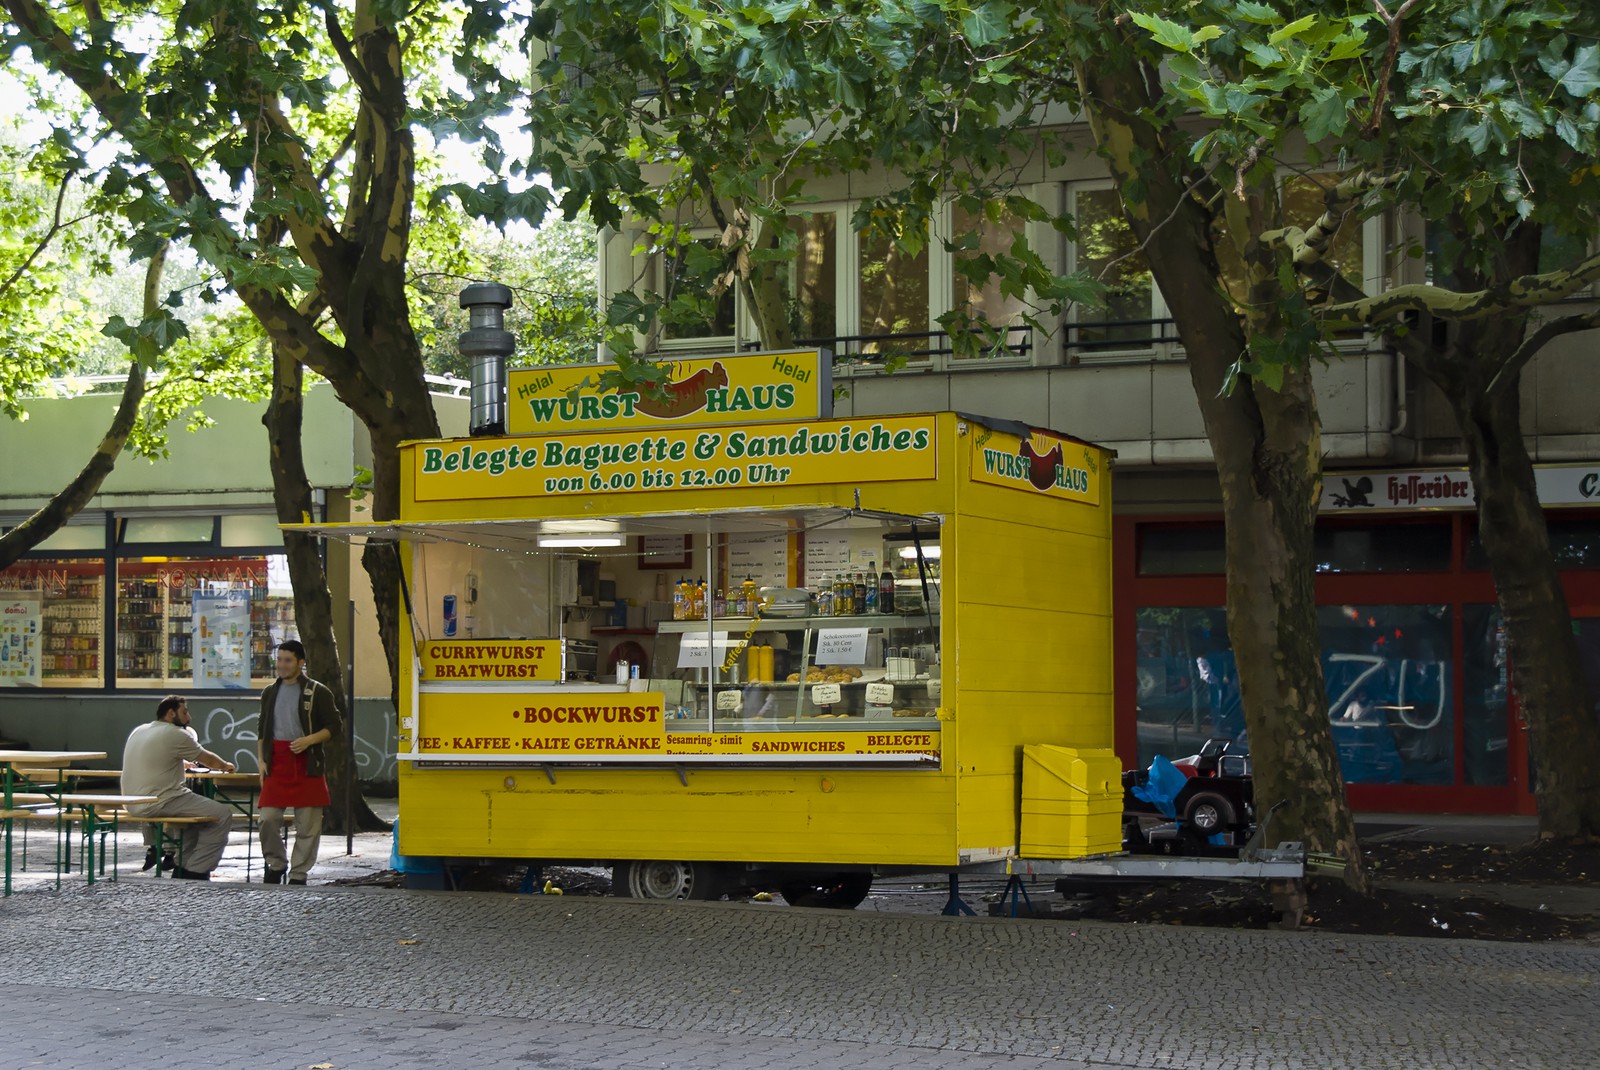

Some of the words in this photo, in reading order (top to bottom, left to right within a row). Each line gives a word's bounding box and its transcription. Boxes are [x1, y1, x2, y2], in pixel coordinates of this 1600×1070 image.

[772, 356, 811, 383] Helal
[517, 372, 554, 400] Helal
[529, 392, 640, 423] WURST
[705, 383, 796, 413] HAUS
[423, 446, 538, 476] Belegte
[542, 438, 687, 472] Baguette
[693, 433, 722, 460] &
[725, 425, 929, 459] Sandwiches
[544, 477, 584, 493] von
[588, 472, 637, 491] 6.00
[642, 468, 675, 489] bis
[680, 467, 742, 487] 12.00
[747, 464, 792, 484] Uhr
[983, 448, 1031, 481] WURST
[1055, 465, 1088, 494] HAUS
[430, 646, 546, 660] CURRYWURST
[720, 640, 747, 674] Kaffee
[435, 664, 538, 678] BRATWURST
[523, 706, 661, 724] BOCKWURST
[452, 737, 511, 750] KAFFEE
[521, 738, 570, 750] KALTE
[574, 734, 662, 750] GETRÄNKE
[666, 734, 712, 747] Sesamring
[720, 735, 743, 745] simit
[751, 741, 847, 753] SANDWICHES
[867, 735, 931, 746] BELEGTE
